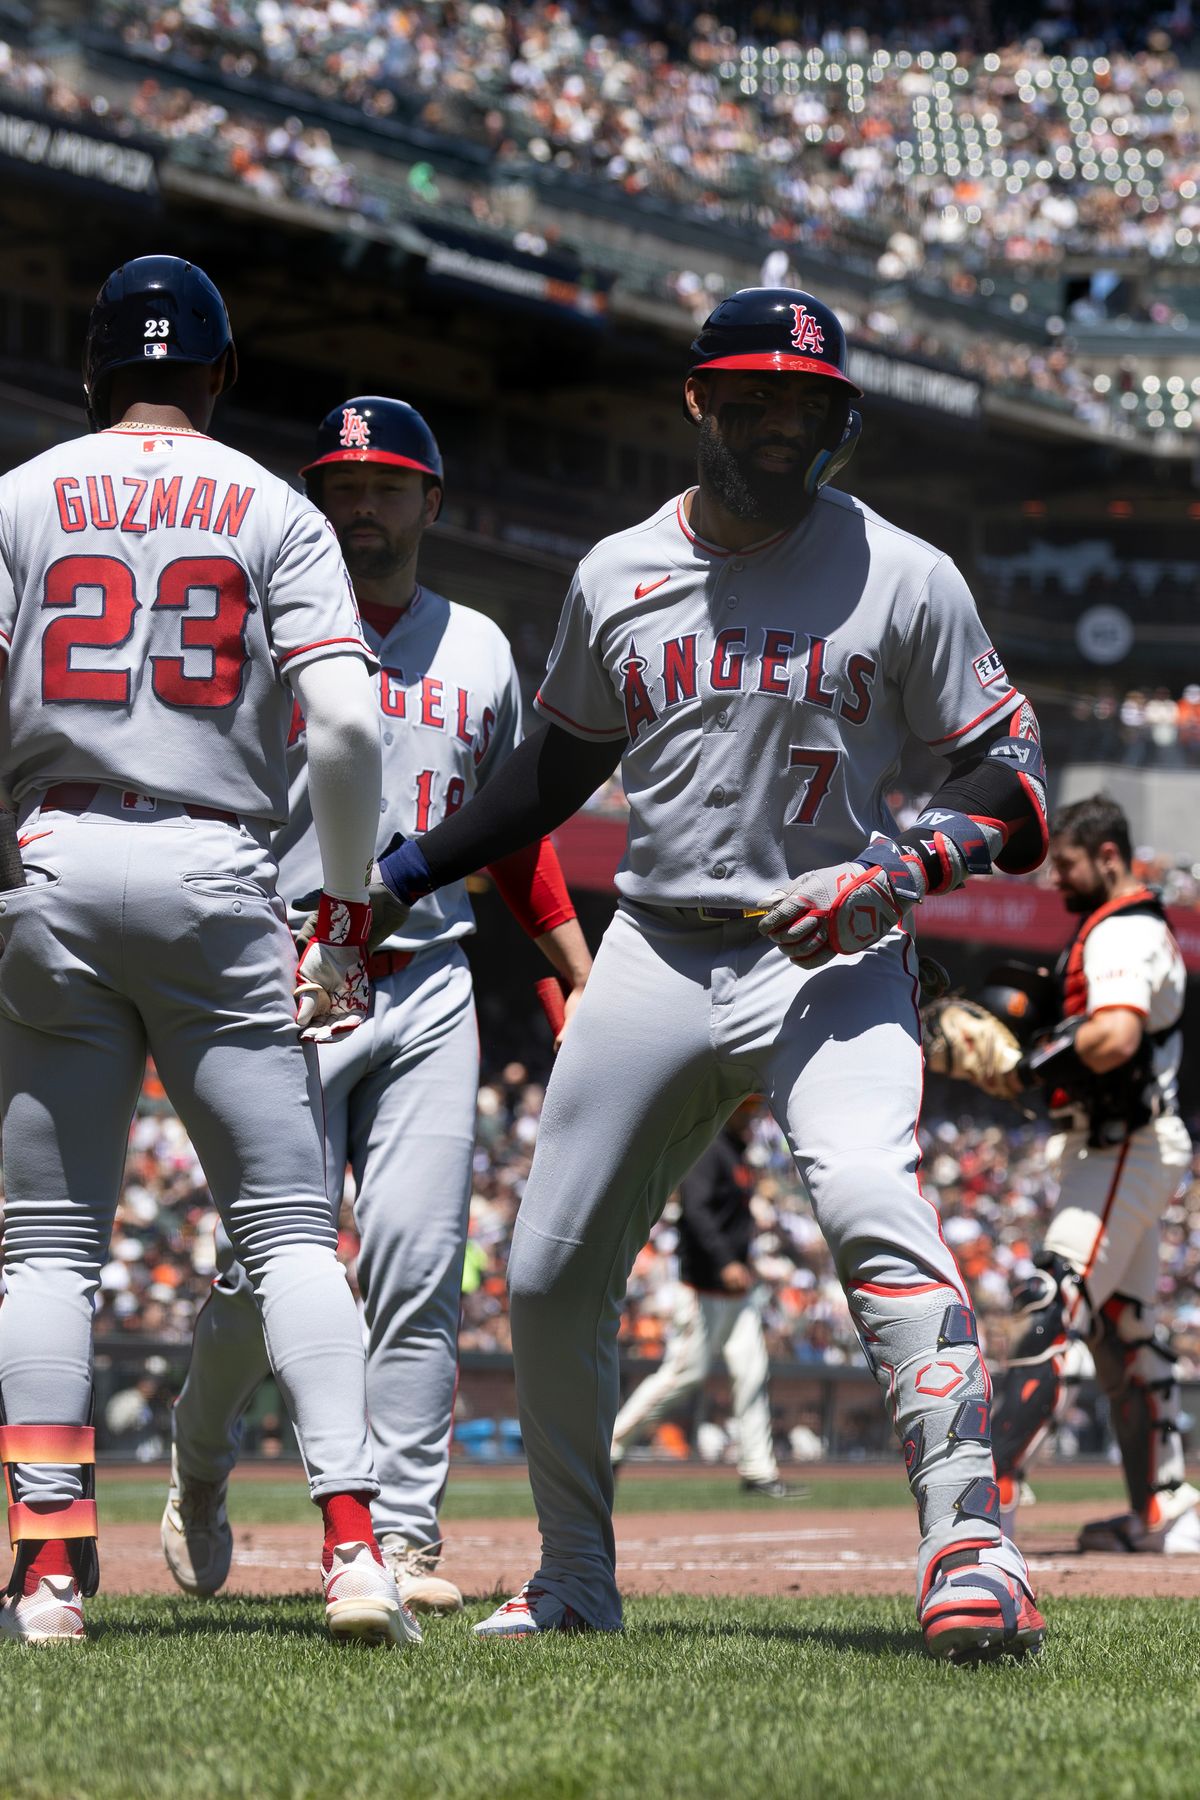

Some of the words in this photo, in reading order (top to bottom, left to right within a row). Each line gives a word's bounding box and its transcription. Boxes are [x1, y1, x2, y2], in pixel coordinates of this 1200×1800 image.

[143, 318, 170, 338] 23
[789, 303, 825, 354] LA
[339, 407, 371, 447] LA
[53, 475, 257, 538] GUZMAN
[41, 554, 257, 709] 23
[618, 626, 878, 746] ANGELS
[786, 744, 841, 827] 7
